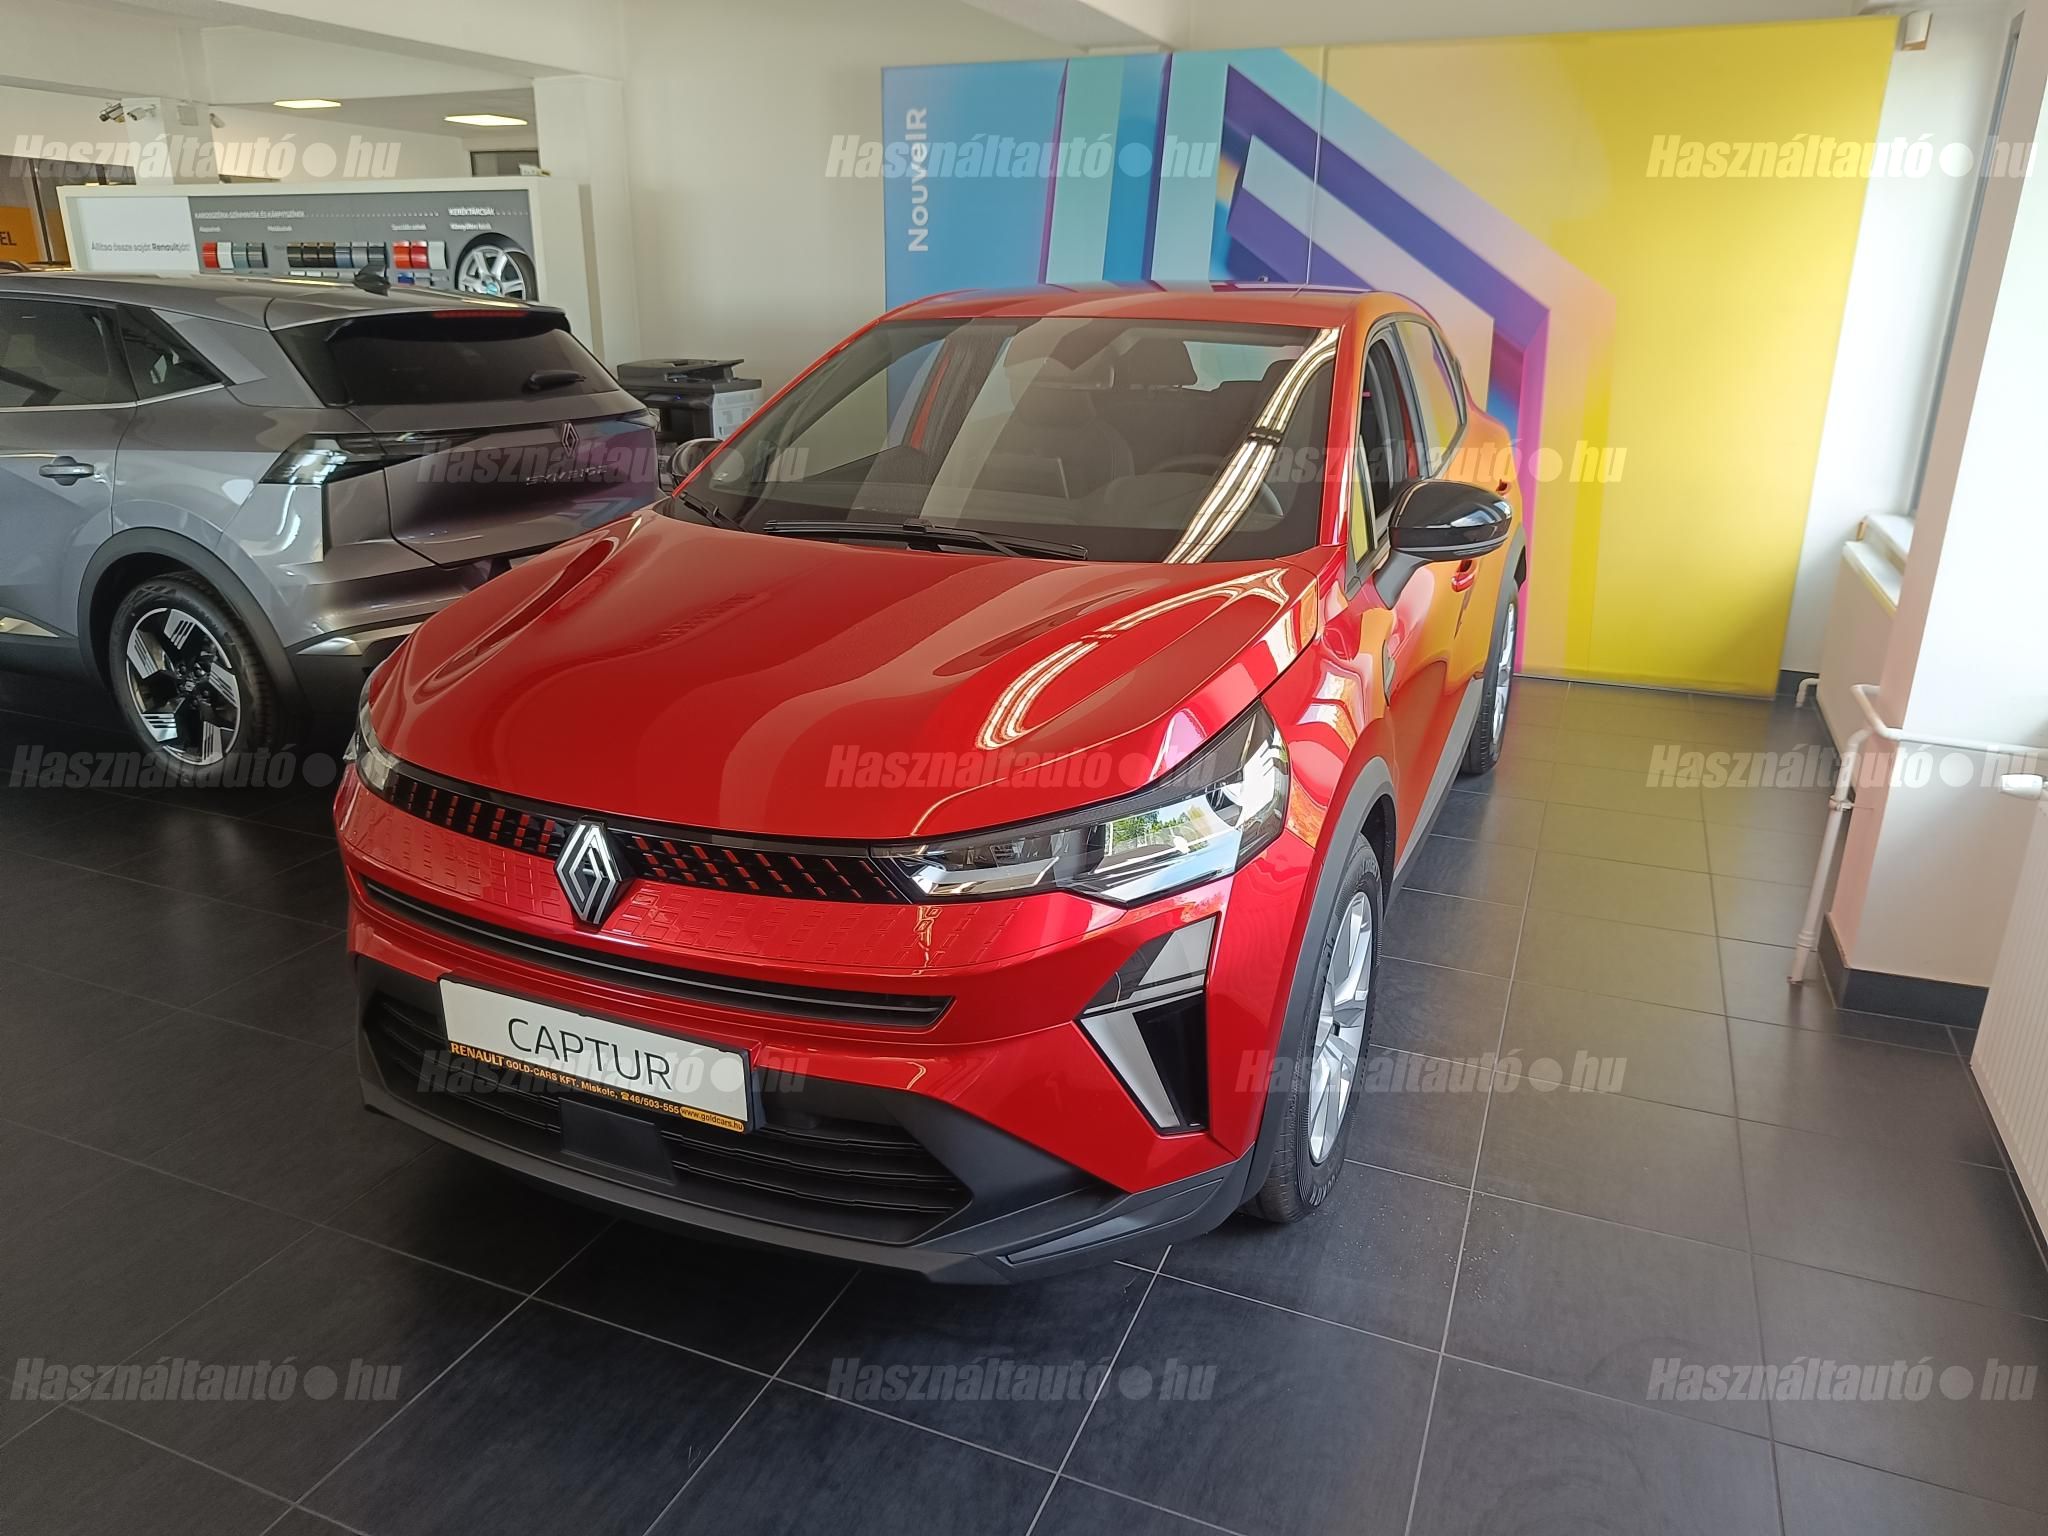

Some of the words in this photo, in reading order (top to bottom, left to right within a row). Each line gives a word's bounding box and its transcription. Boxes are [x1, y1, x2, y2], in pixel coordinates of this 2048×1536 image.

[450, 1042, 505, 1067] RENAULT
[505, 1059, 558, 1081] GOLD-CARS
[559, 1074, 580, 1088] KFT.
[680, 1107, 743, 1131] www.goldcars.hu
[508, 1017, 673, 1090] CAPTUR
